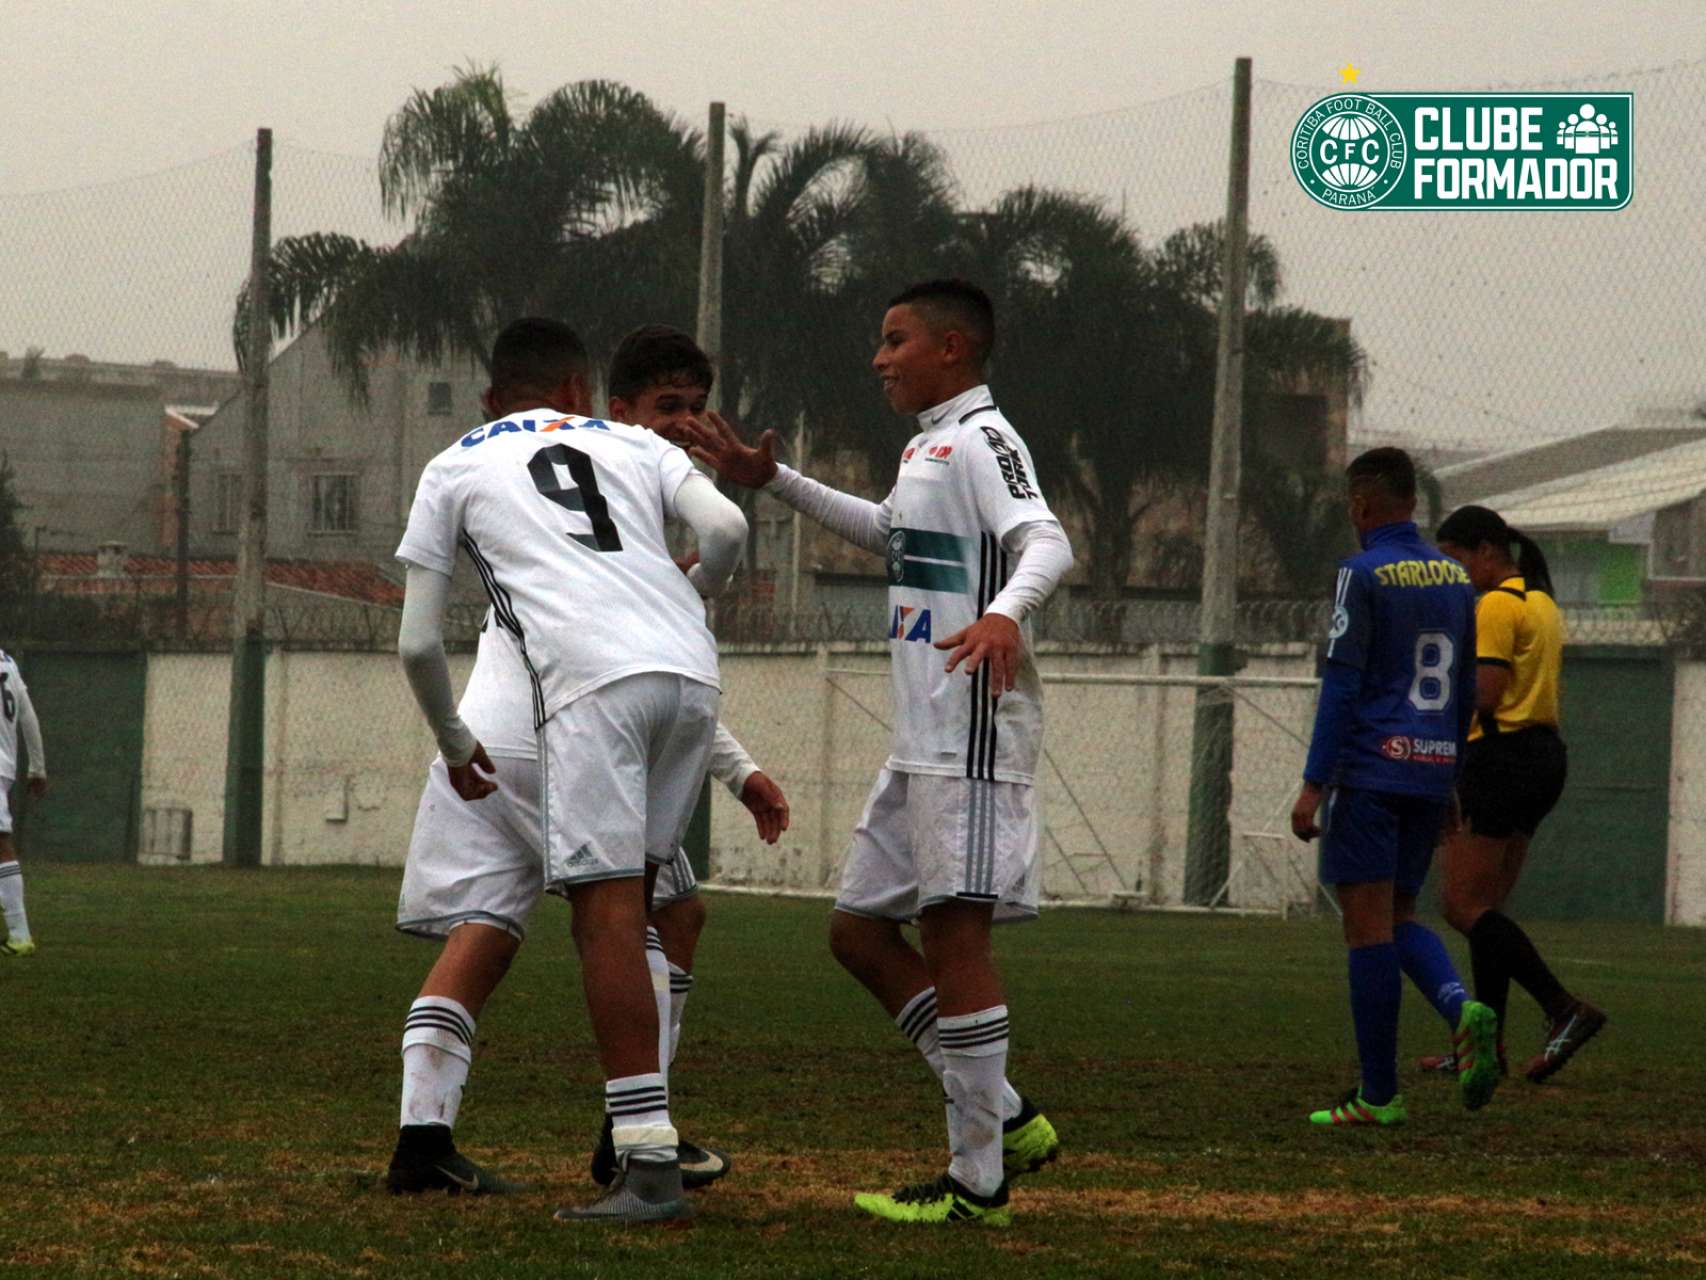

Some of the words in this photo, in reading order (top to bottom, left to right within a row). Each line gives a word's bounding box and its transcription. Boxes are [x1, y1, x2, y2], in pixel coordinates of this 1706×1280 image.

[461, 416, 610, 447] CAIXA
[527, 443, 624, 552] 9
[1408, 632, 1454, 712] 8
